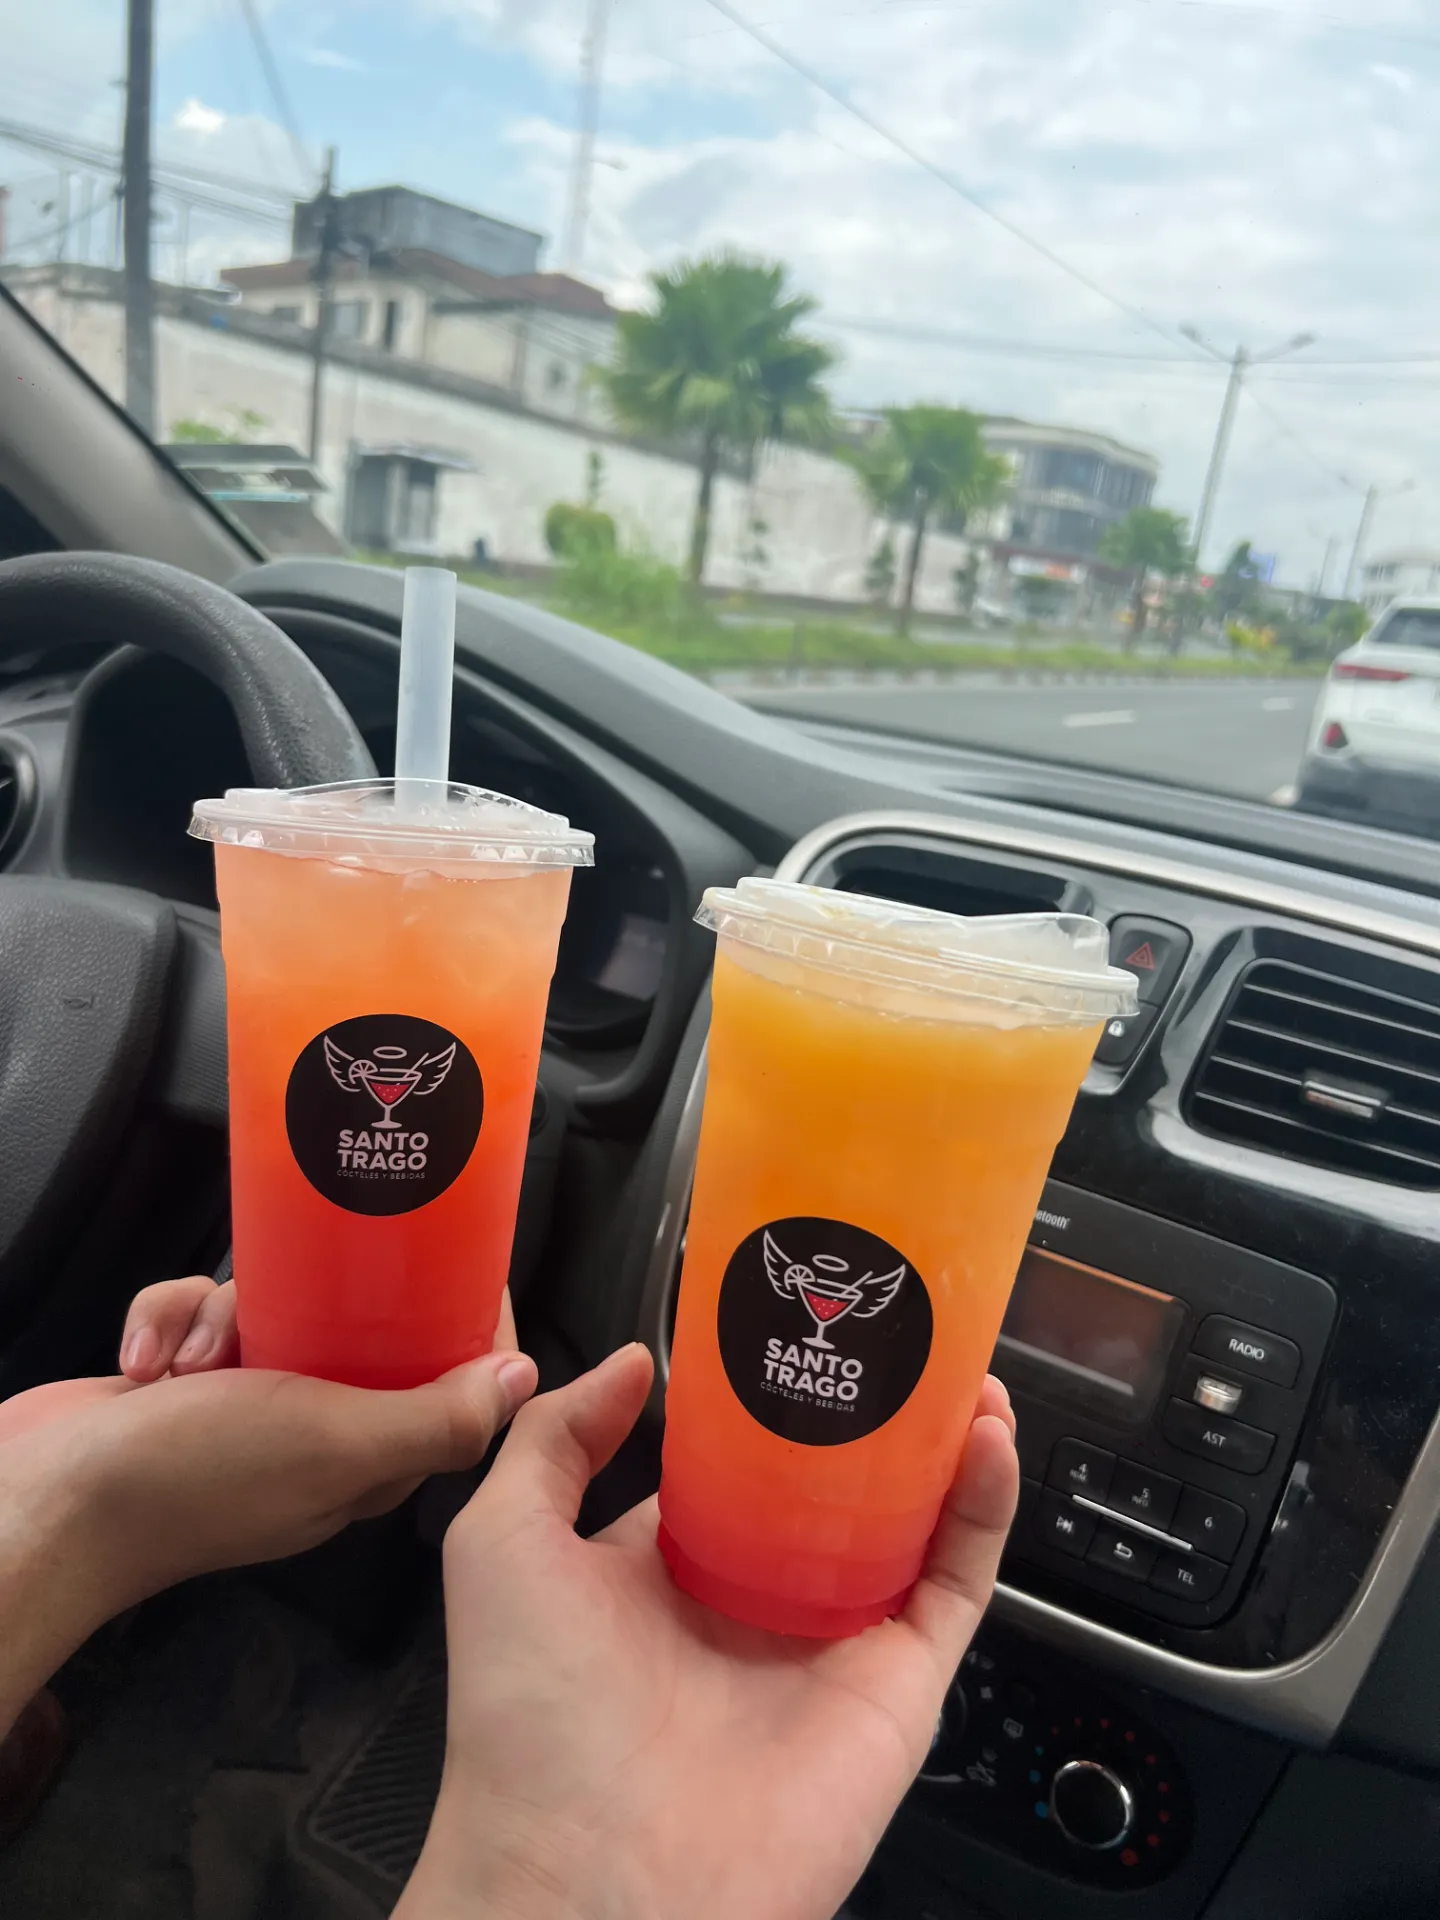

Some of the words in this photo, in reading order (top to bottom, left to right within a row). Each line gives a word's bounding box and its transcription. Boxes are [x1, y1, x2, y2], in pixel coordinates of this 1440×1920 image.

[338, 1129, 429, 1151] SANTO
[337, 1149, 427, 1171] TRAGO
[382, 1172, 389, 1180] Y
[390, 1172, 426, 1180] BEBIDAS
[1036, 1209, 1068, 1230] etooth
[765, 1337, 863, 1380] SANTO
[1228, 1338, 1265, 1361] RADIO
[763, 1358, 859, 1402] TRAGO
[807, 1396, 814, 1404] Y
[815, 1398, 855, 1412] BEBIDAS
[1202, 1430, 1227, 1448] AST
[1078, 1463, 1087, 1473] 4
[1142, 1487, 1150, 1499] 5
[1204, 1516, 1213, 1528] 6
[1177, 1567, 1196, 1586] TEL
